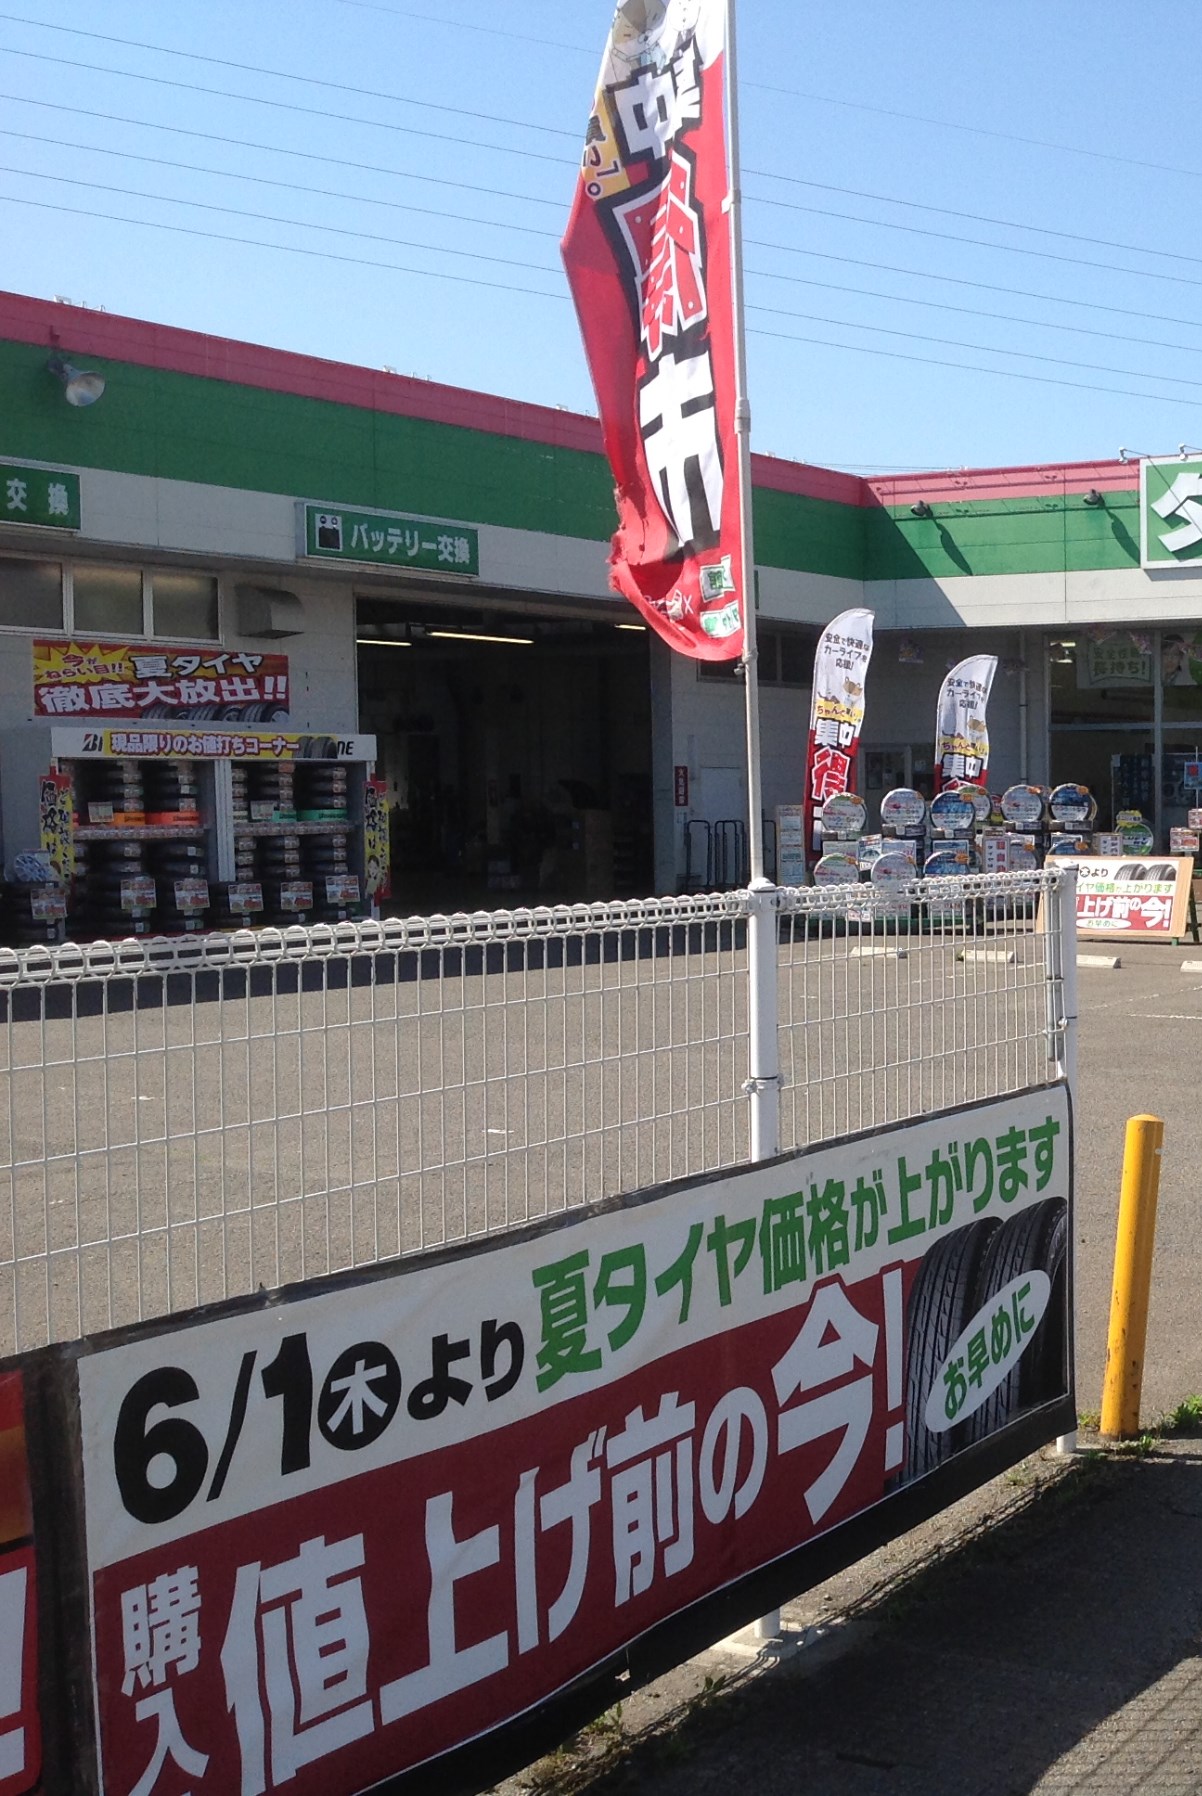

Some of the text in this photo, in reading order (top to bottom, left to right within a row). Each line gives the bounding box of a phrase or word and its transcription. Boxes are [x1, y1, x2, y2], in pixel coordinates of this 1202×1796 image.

[351, 522, 472, 565] バッテリー交換
[130, 653, 264, 679] 夏タイヤ
[38, 676, 287, 713] 徹底大放出!!
[110, 732, 300, 757] 現品限りのお値打ちコーナー
[1076, 896, 1173, 928] 上げ前の今!
[531, 1116, 1063, 1393] 夏タイヤ価格が上がります
[941, 1281, 1041, 1420] お早めに
[219, 1265, 910, 1796] 値上げ前の今!
[120, 1564, 209, 1796] 購入
